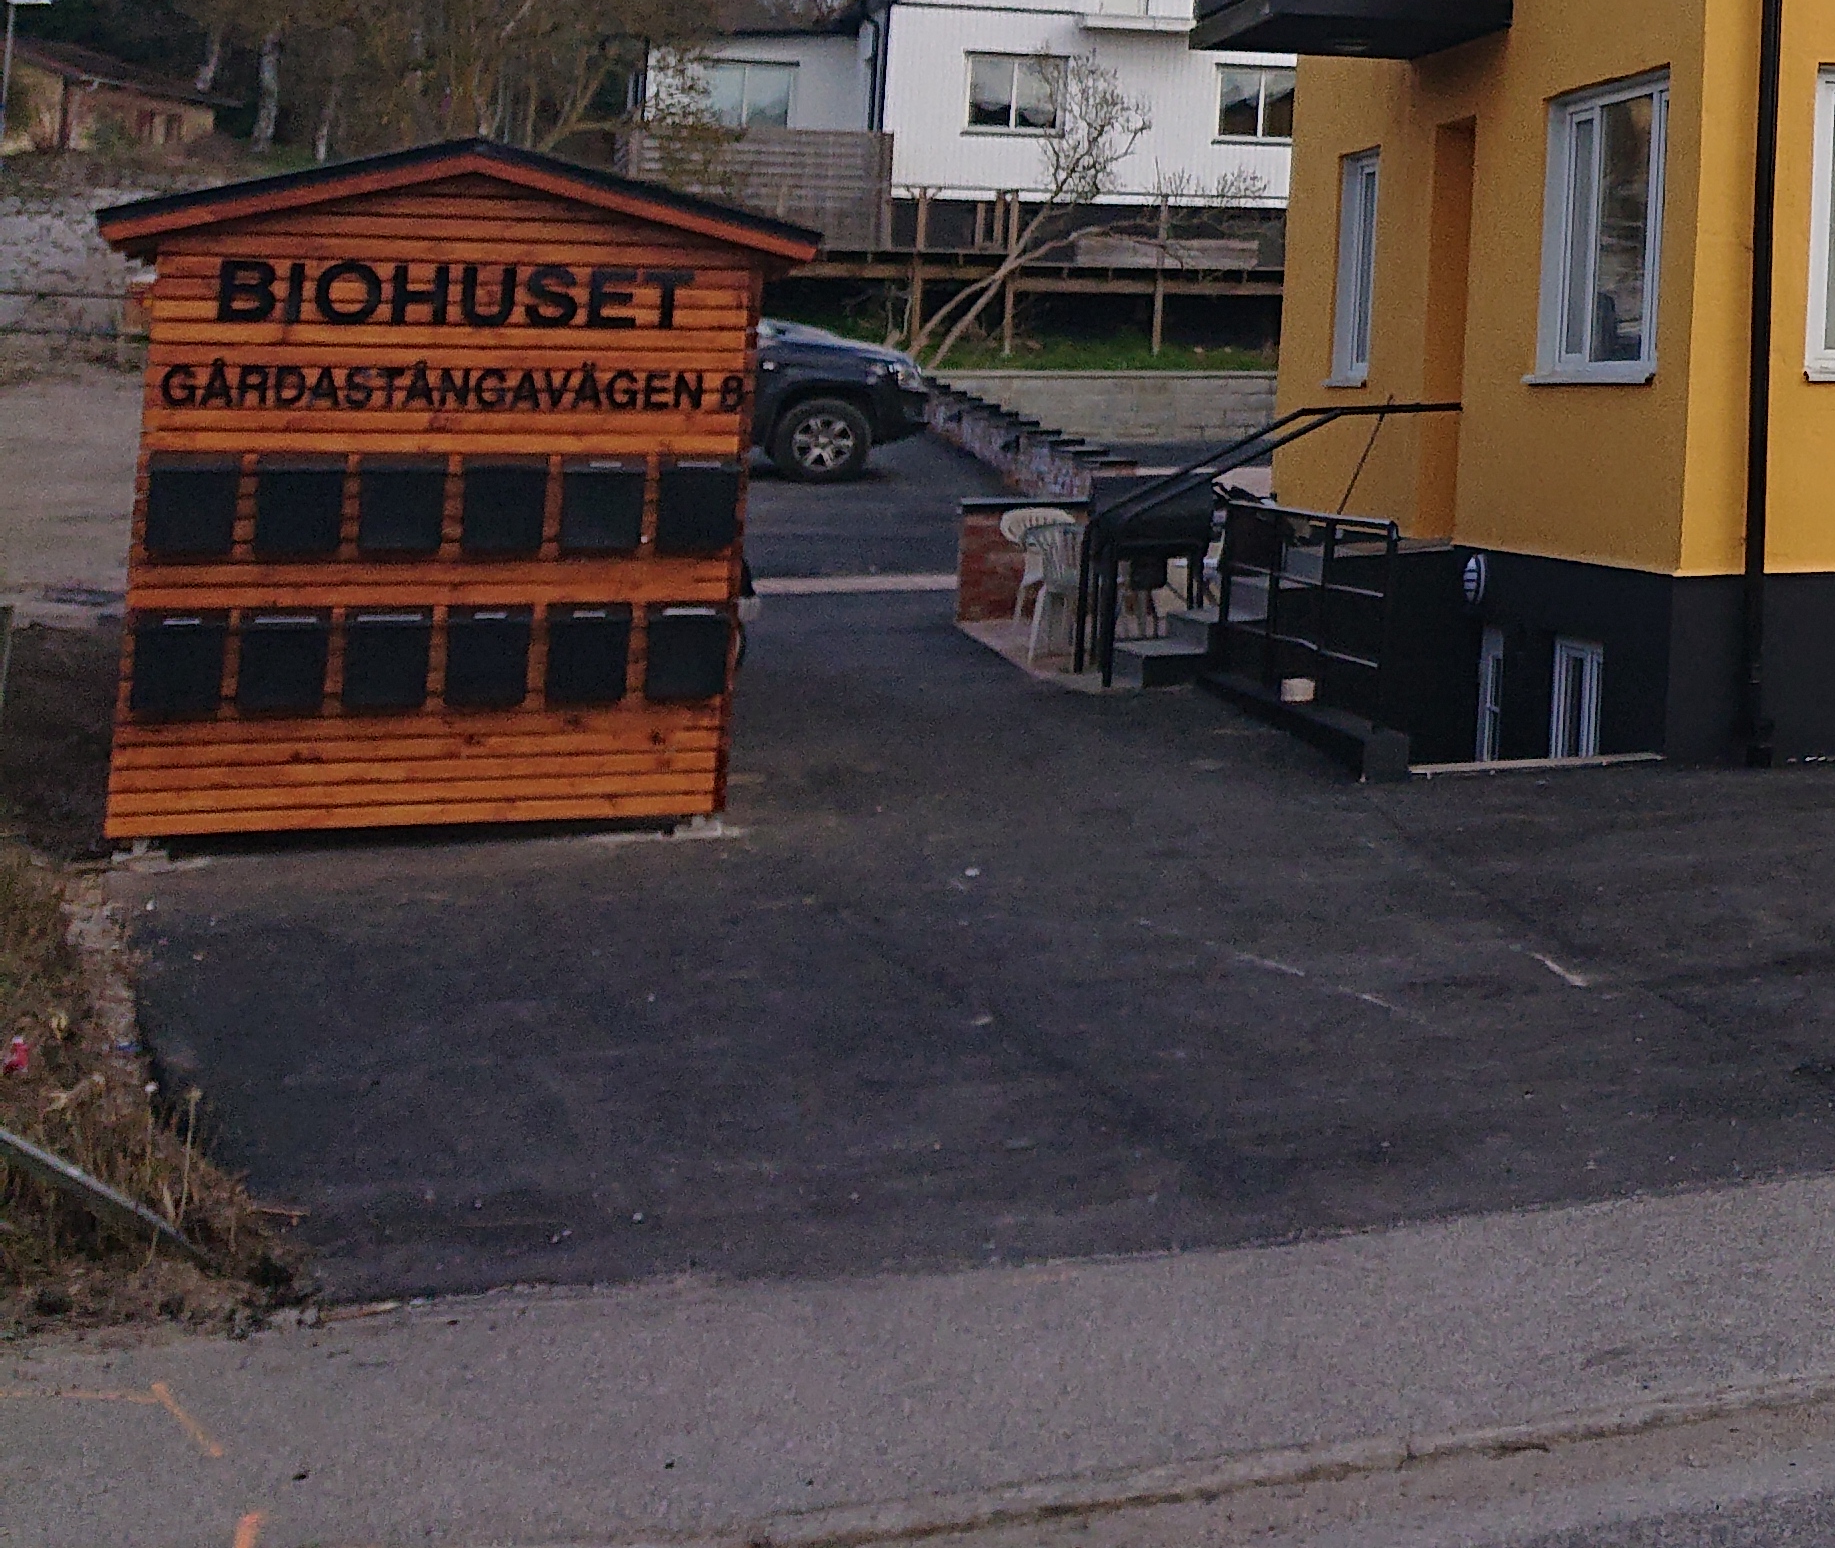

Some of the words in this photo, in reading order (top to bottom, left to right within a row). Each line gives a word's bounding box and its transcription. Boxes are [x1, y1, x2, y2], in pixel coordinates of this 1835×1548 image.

[217, 259, 695, 330] BIOHUSET
[162, 357, 704, 409] GÅRDASTÅNGAVÄGEN
[720, 375, 744, 410] 8
